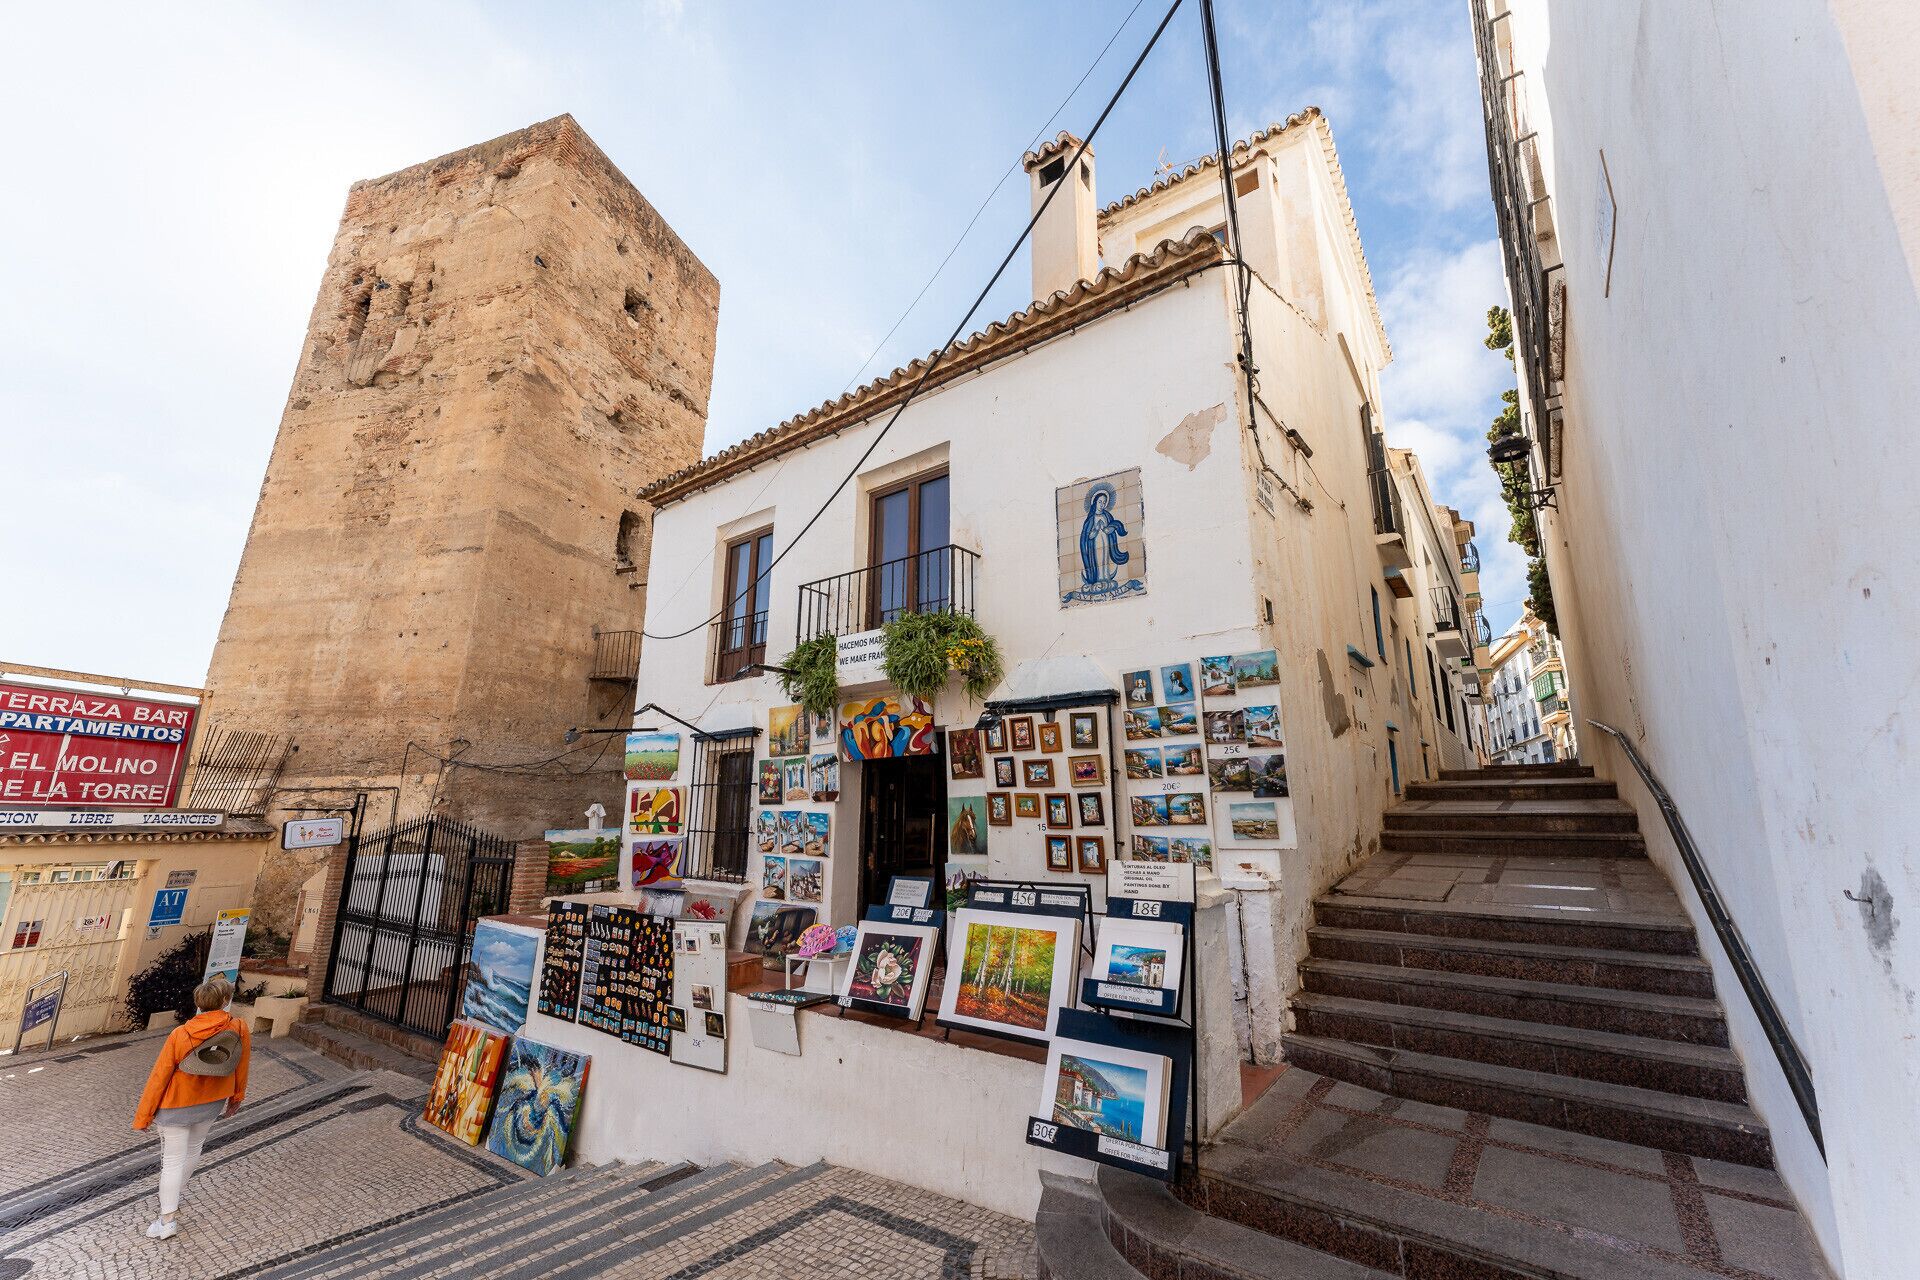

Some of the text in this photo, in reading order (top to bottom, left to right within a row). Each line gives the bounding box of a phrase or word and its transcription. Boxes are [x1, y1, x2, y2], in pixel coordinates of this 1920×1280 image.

[838, 638, 868, 651] HACEMOS
[839, 656, 849, 666] WE
[850, 653, 867, 664] MAKE
[133, 706, 183, 725] BAR
[1223, 745, 1241, 755] 25€
[9, 752, 157, 775] EL MOLINO
[0, 779, 164, 801] E LA TORRE
[69, 813, 114, 825] LIBRE
[143, 814, 217, 825] VACANCIES
[158, 891, 185, 907] AT
[1012, 891, 1036, 907] 45€
[896, 908, 910, 917] 20€
[1133, 902, 1160, 916] 18€
[1034, 1124, 1055, 1140] 30€
[1105, 1137, 1125, 1147] OFERTA
[1125, 1142, 1136, 1150] POR
[1104, 1147, 1120, 1157] OFFER
[1121, 1151, 1131, 1159] FOR
